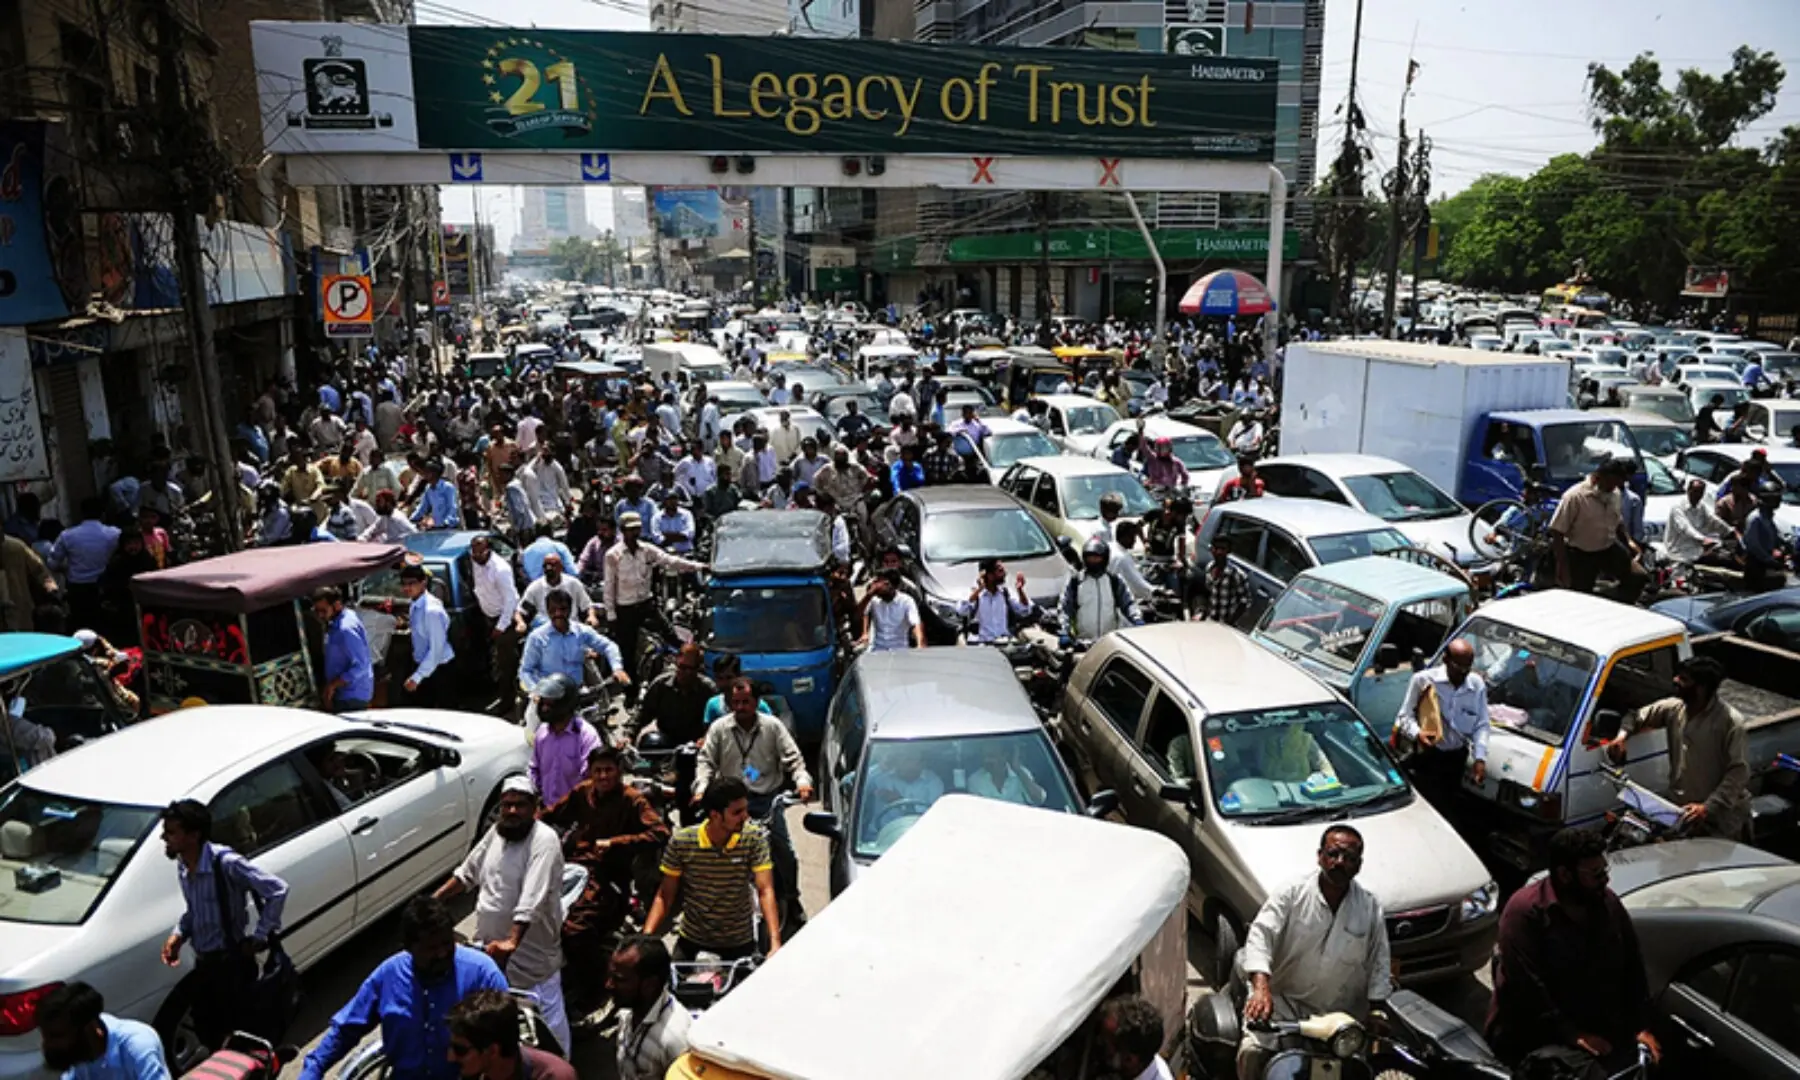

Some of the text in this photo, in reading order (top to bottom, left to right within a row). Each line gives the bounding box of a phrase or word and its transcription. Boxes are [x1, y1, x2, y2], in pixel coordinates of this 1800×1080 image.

[499, 57, 579, 116] 21
[640, 52, 1157, 137] A Legacy of Trust
[339, 283, 359, 313] P
